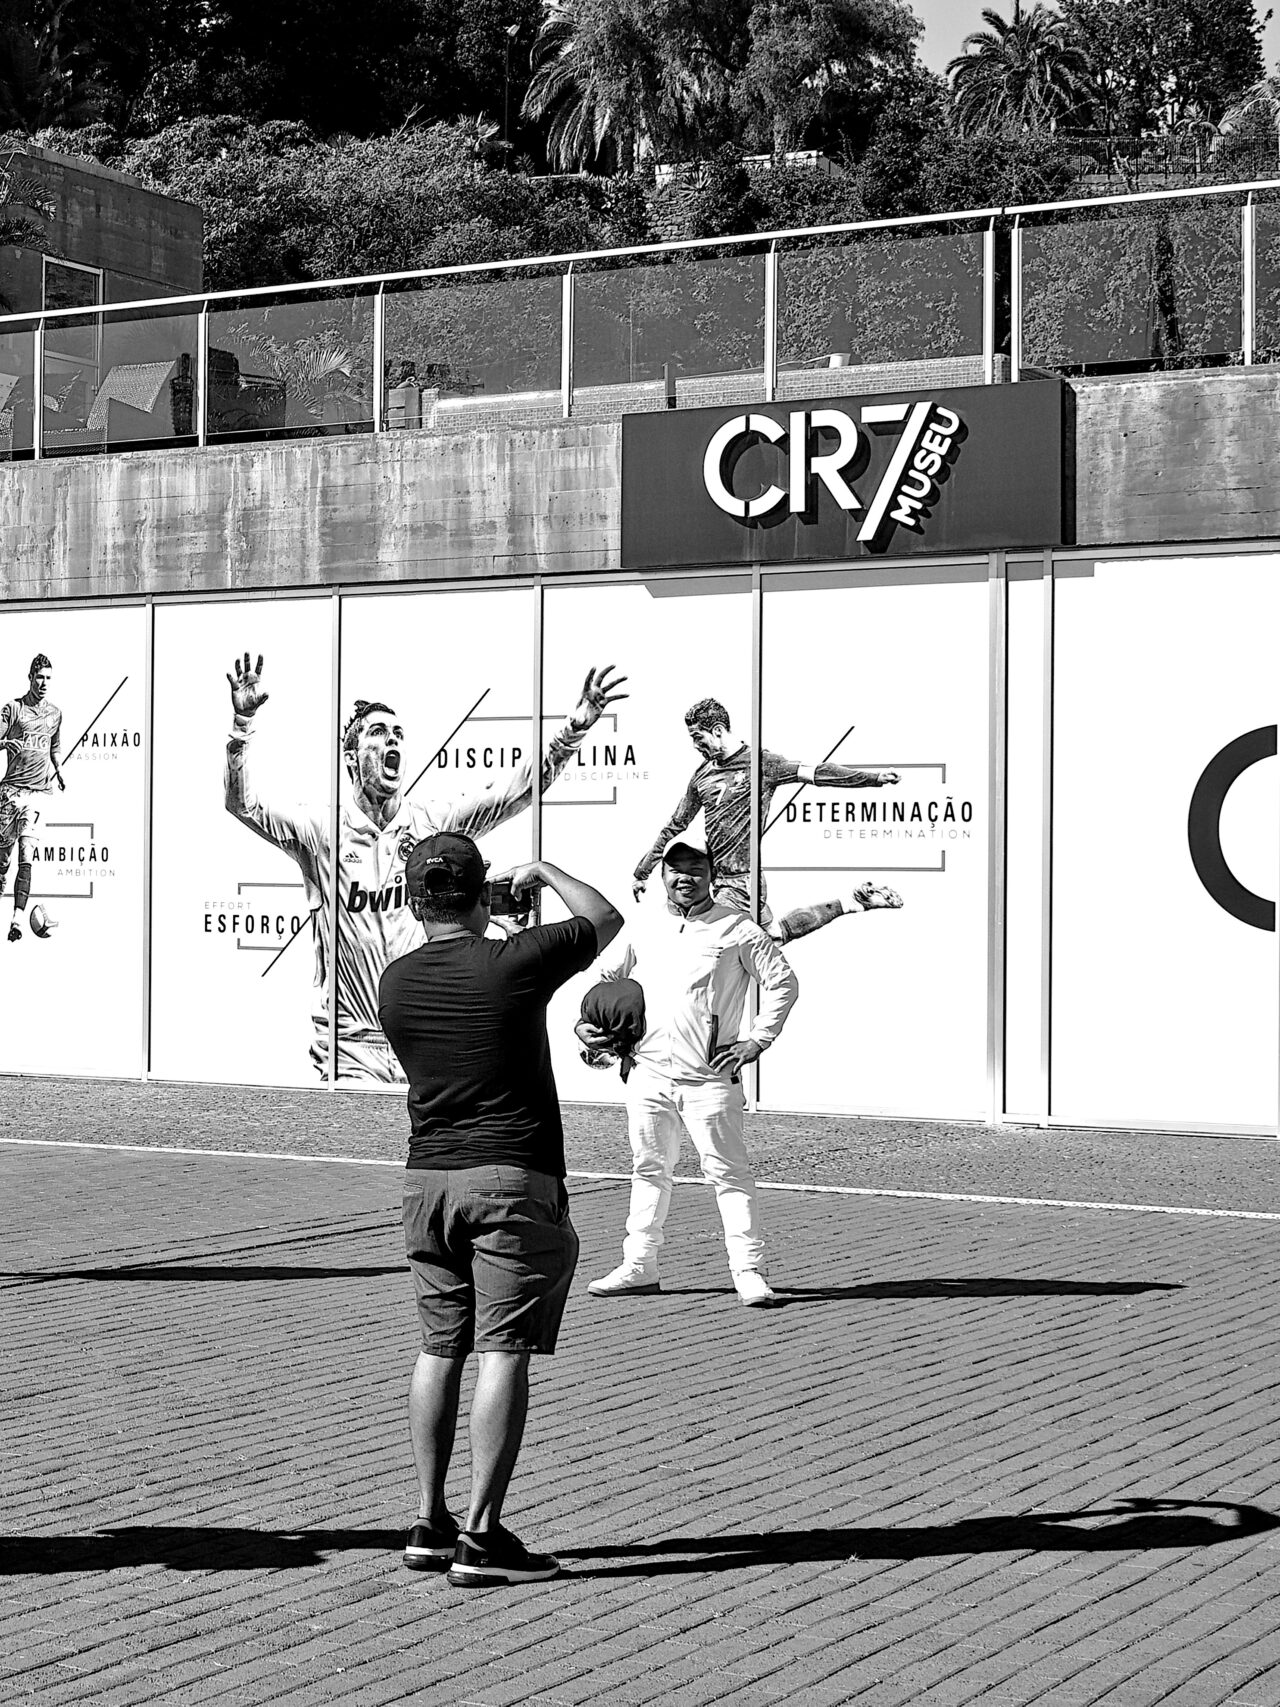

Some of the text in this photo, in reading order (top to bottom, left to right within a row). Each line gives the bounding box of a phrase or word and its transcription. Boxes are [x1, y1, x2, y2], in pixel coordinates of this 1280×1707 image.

[703, 401, 933, 541] CR7
[889, 407, 960, 526] MUSEU
[24, 734, 50, 748] AIG
[81, 729, 141, 748] PAIXÃO
[69, 753, 118, 761] PASSION
[564, 771, 649, 781] DISCIPLINE
[715, 782, 727, 805] 7
[34, 810, 40, 824] 7
[786, 796, 973, 828] DETERMINAÇÃO
[823, 829, 971, 839] DETERMINATION
[32, 843, 110, 866] AMBIÇÃO
[57, 869, 116, 878] AMBITION
[204, 901, 252, 910] EFFORT
[204, 914, 301, 940] ESFORÇO
